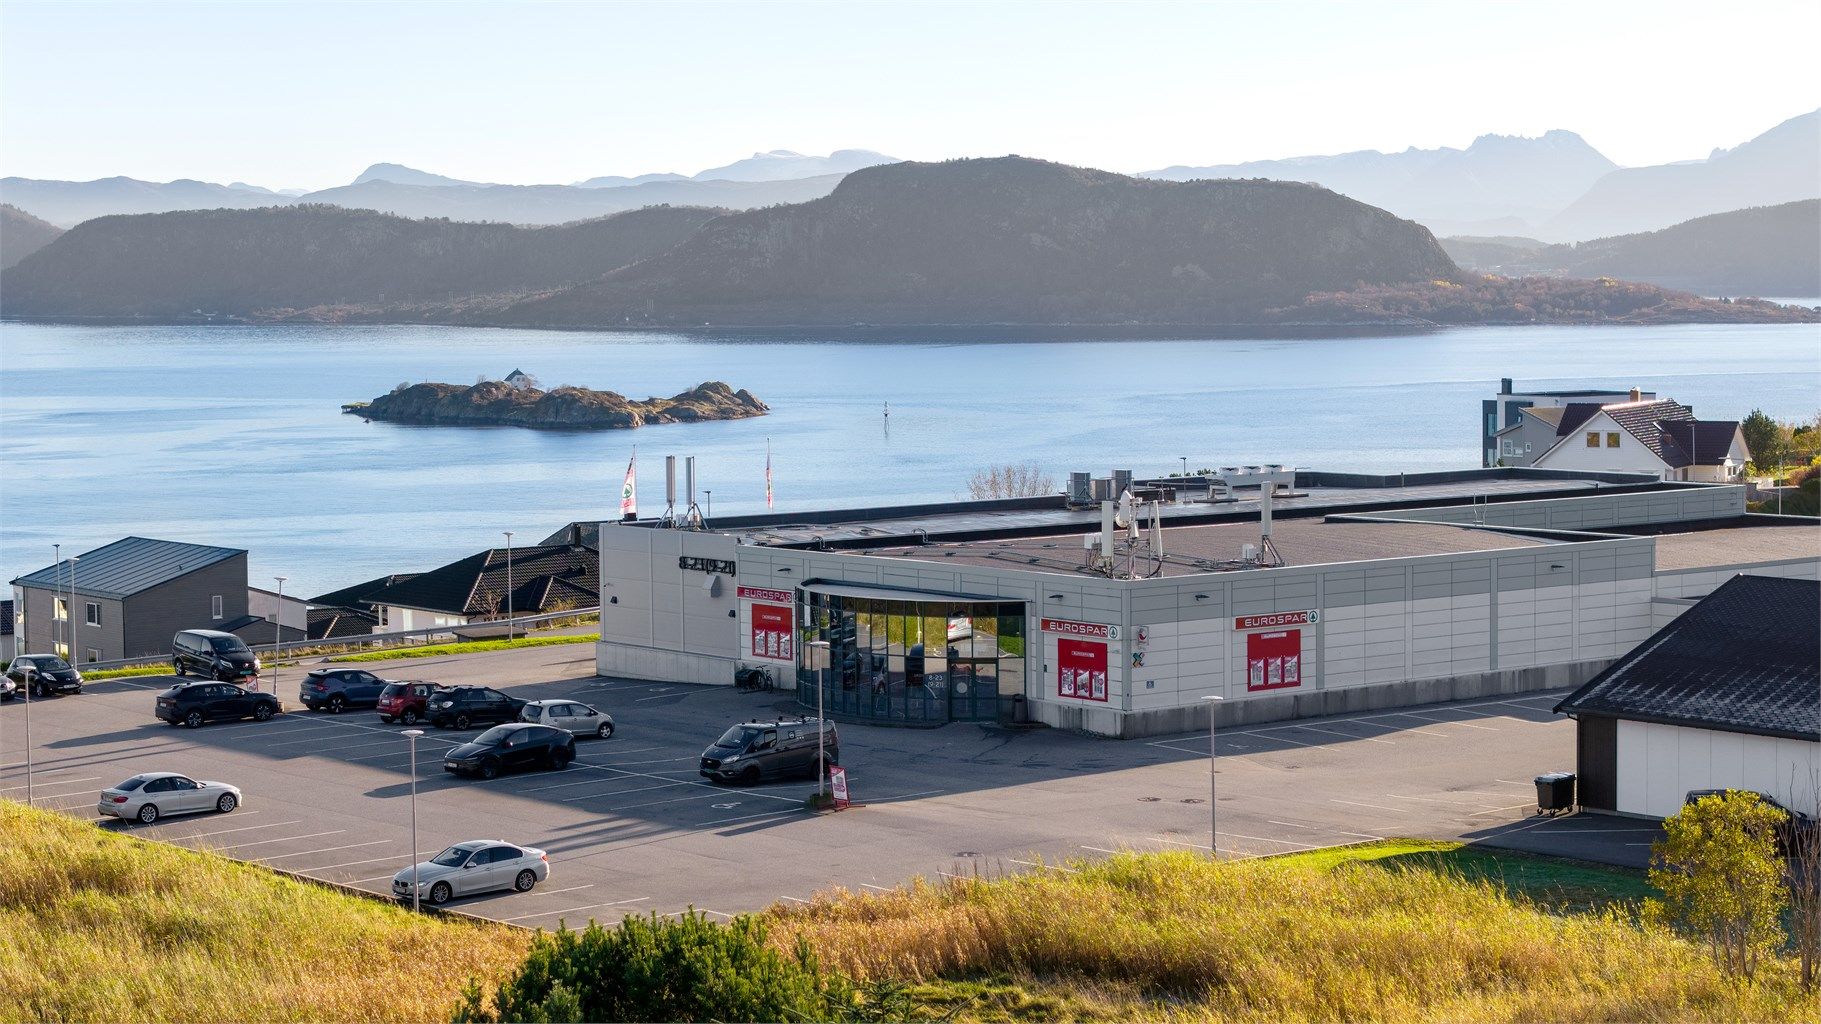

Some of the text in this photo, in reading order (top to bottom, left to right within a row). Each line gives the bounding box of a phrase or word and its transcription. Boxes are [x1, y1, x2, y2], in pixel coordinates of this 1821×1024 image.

[744, 589, 792, 602] EUROSPAR
[1245, 613, 1307, 627] EUROSPAR
[1050, 622, 1108, 636] EUROSPAR
